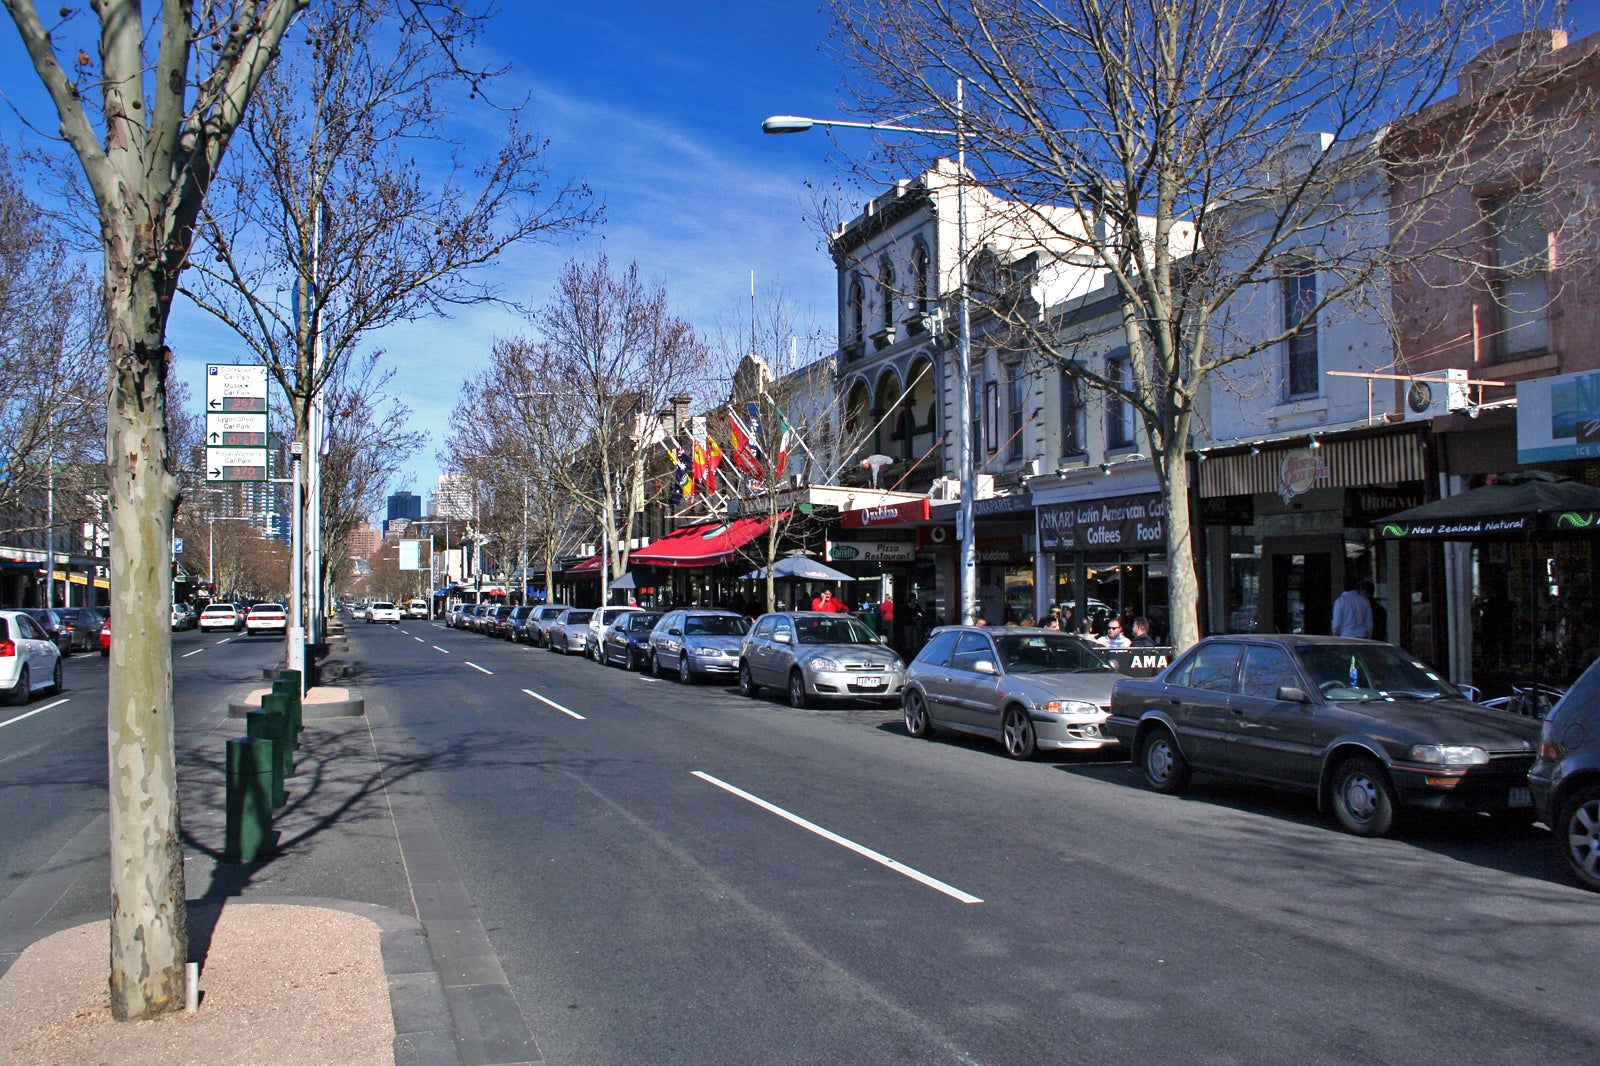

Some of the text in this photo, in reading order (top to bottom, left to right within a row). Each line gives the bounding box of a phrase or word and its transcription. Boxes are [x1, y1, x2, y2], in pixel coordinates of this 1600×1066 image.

[1576, 446, 1591, 455] ICE
[973, 498, 1012, 513] ONAPARTE
[1077, 508, 1099, 524] Latin
[1101, 504, 1145, 521] American
[1087, 520, 1161, 544] Coffees Food
[1411, 518, 1523, 534] New Zealand Natural
[876, 543, 898, 552] Pizza
[864, 551, 910, 561] Restaurant
[1129, 655, 1168, 669] AMA
